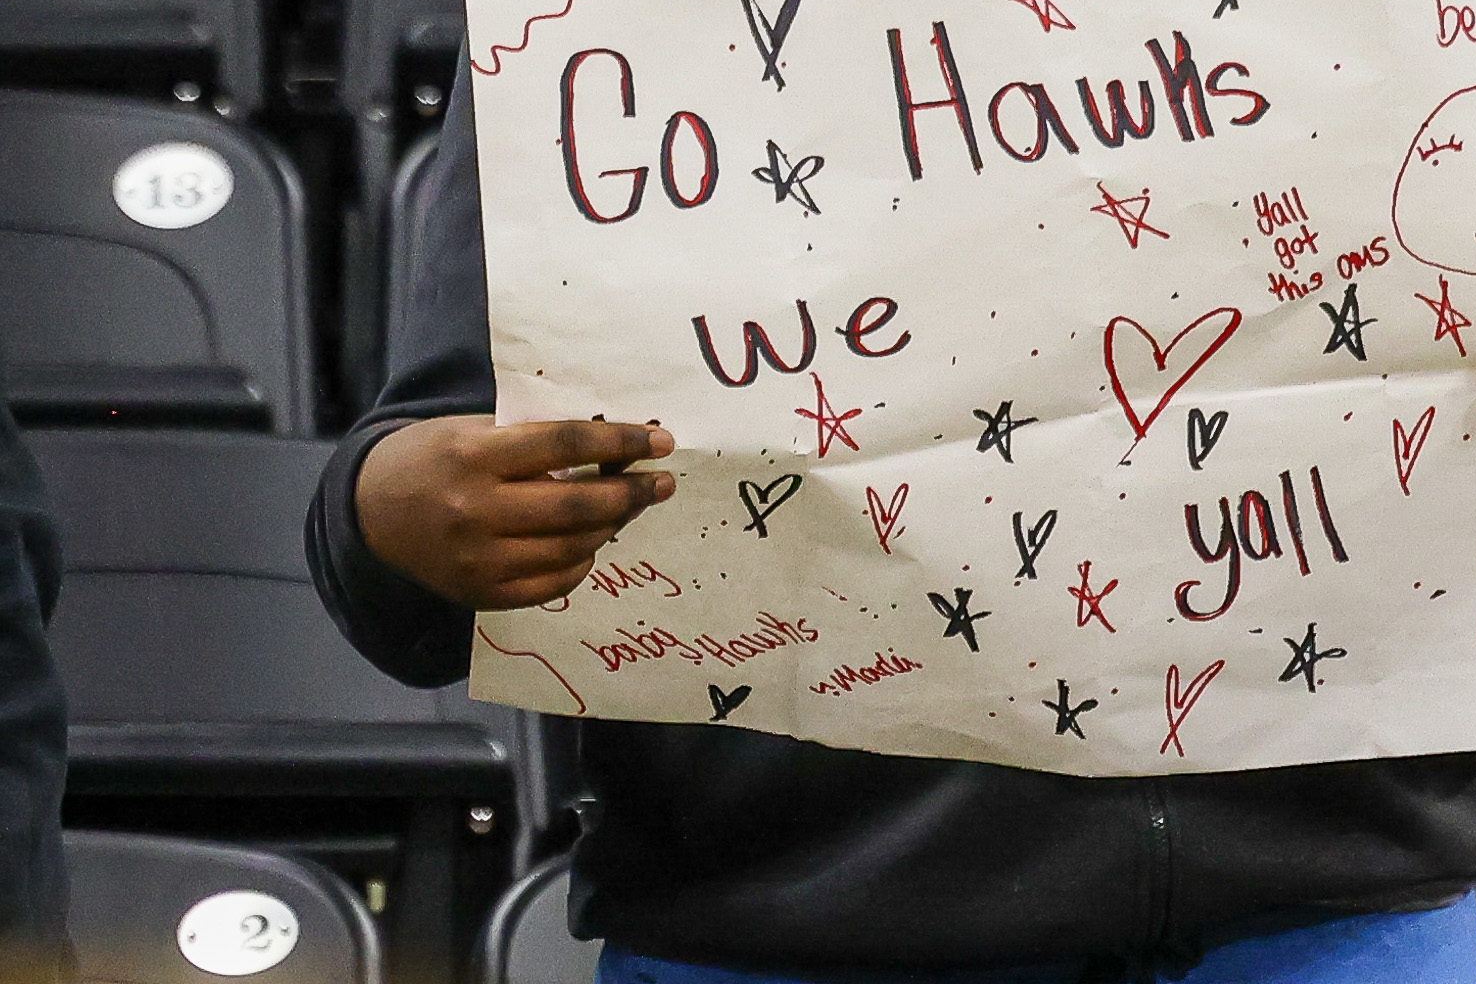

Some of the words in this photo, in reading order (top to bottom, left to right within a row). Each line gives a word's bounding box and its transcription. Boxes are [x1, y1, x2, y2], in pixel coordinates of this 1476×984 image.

[559, 47, 719, 225] Go
[886, 20, 1272, 182] Hawks
[147, 172, 204, 210] 13
[1273, 223, 1320, 270] got
[1267, 269, 1324, 303] this
[1174, 465, 1349, 621] yall
[578, 626, 704, 673] baby
